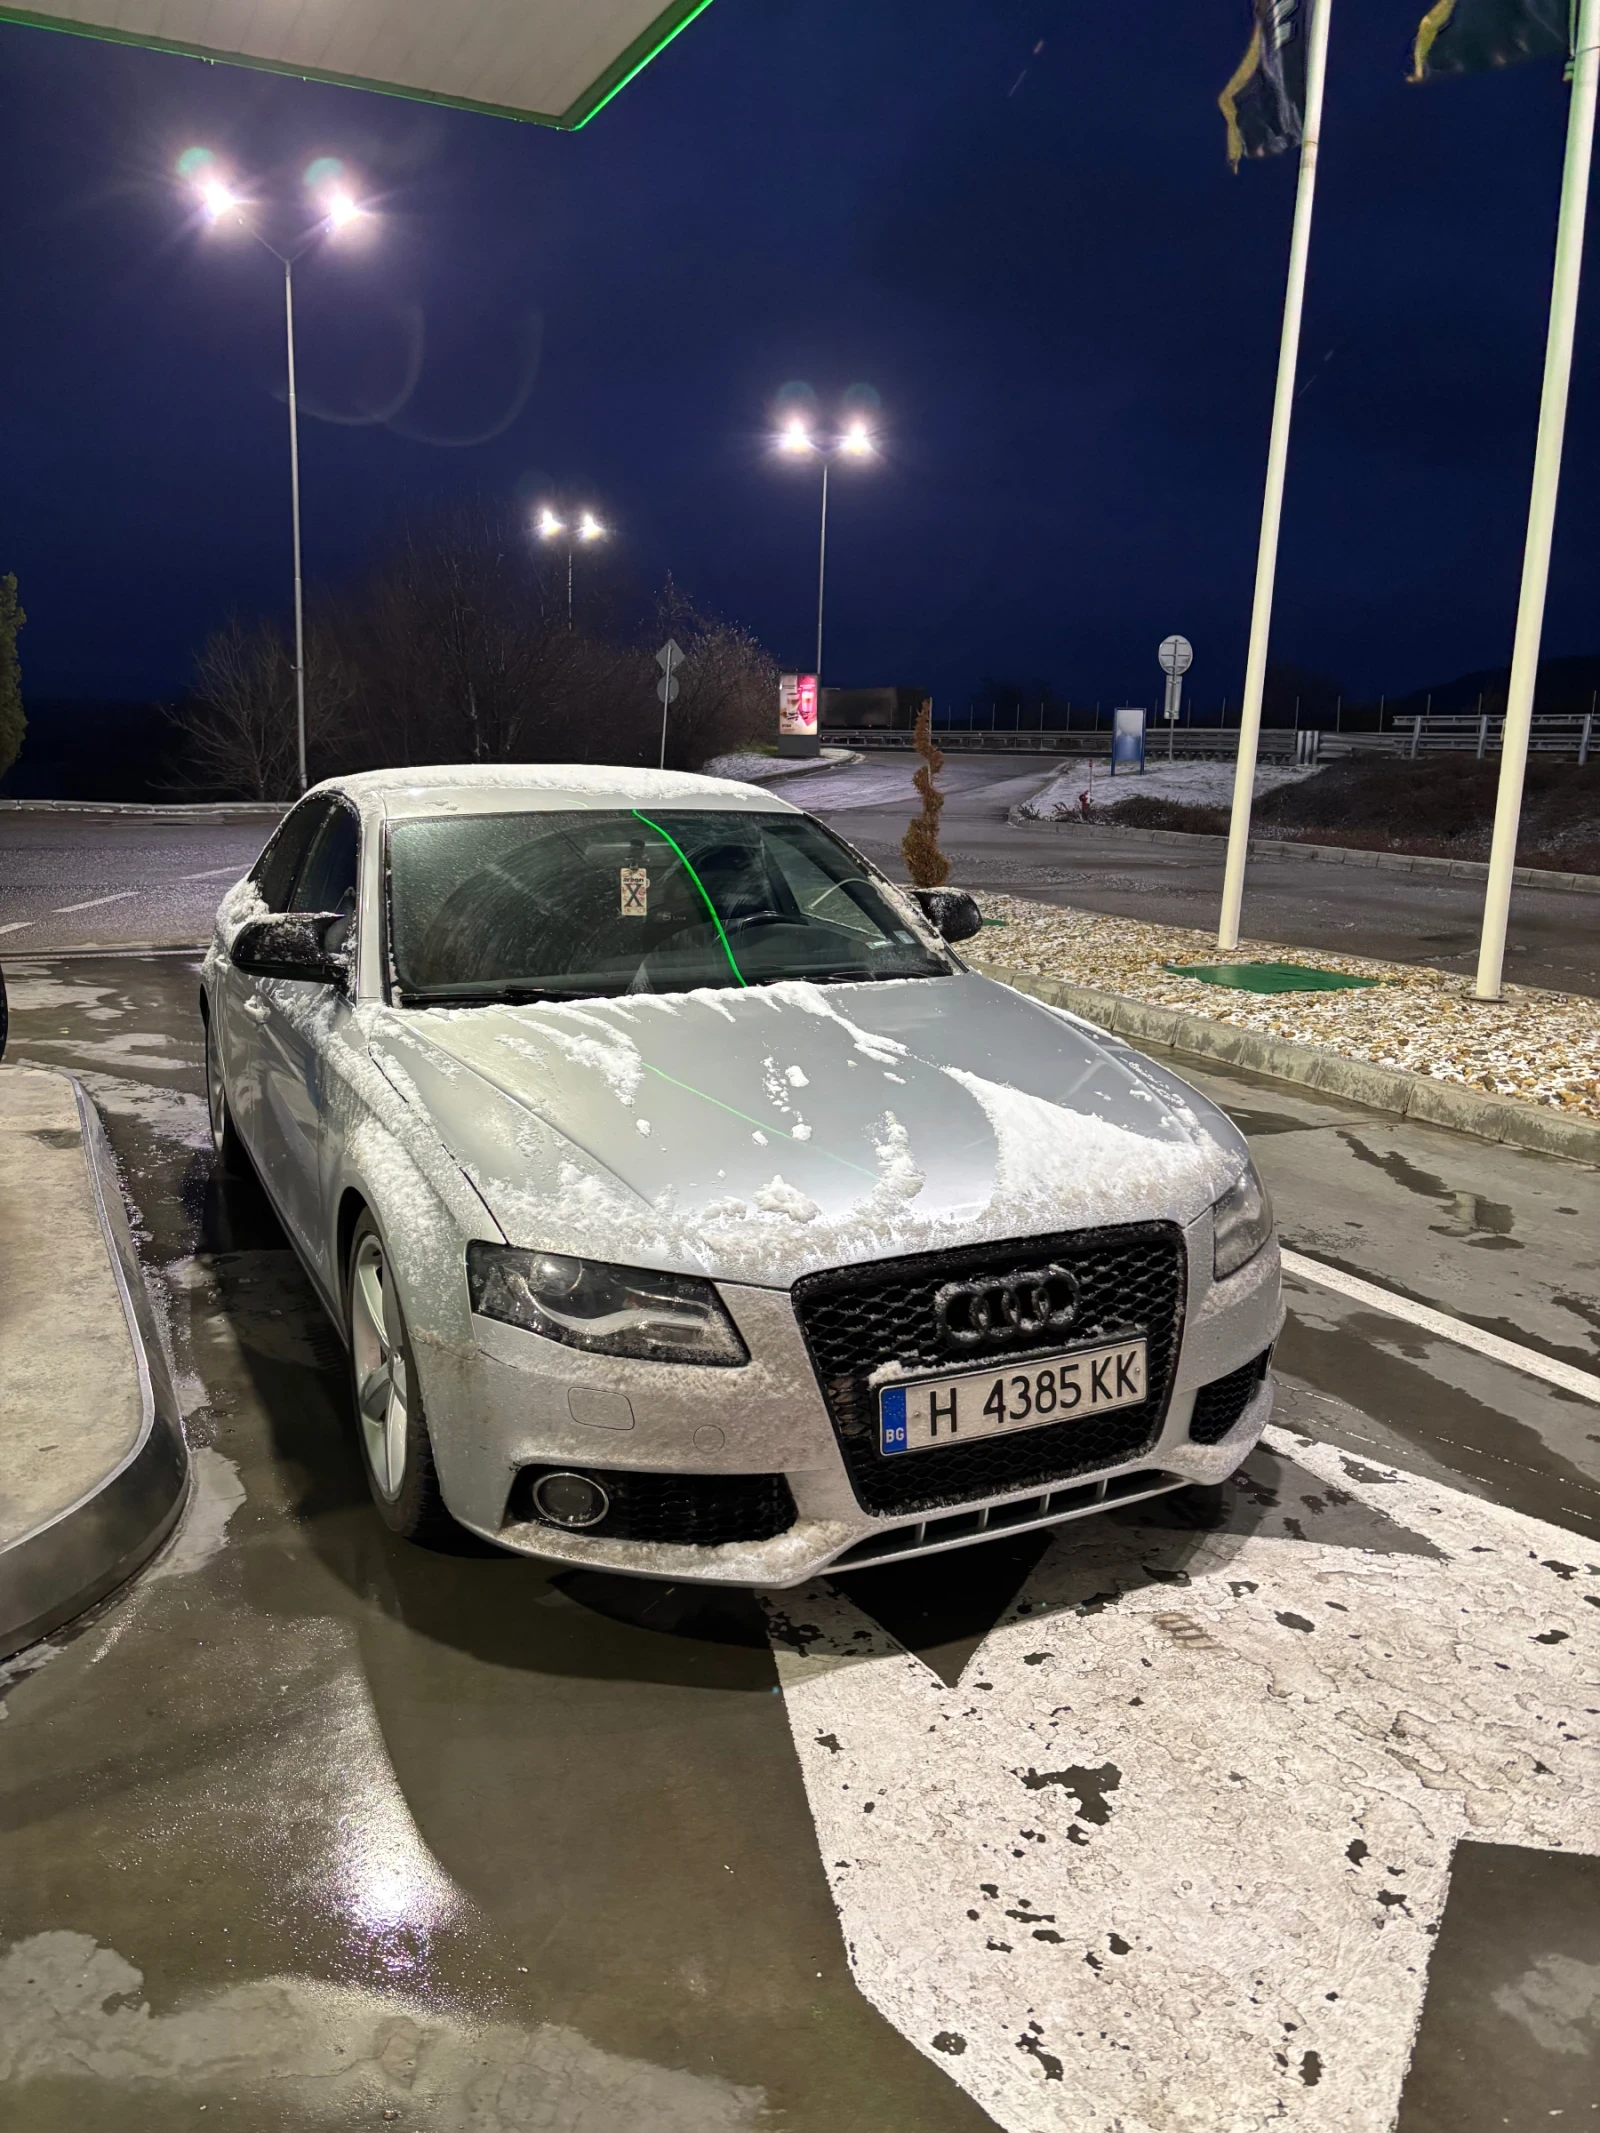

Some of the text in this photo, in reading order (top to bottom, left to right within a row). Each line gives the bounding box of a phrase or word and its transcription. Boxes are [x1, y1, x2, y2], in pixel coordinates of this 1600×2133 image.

[623, 883, 644, 907] X
[929, 1351, 1138, 1436] H 4385 KK
[886, 1428, 905, 1444] BG
